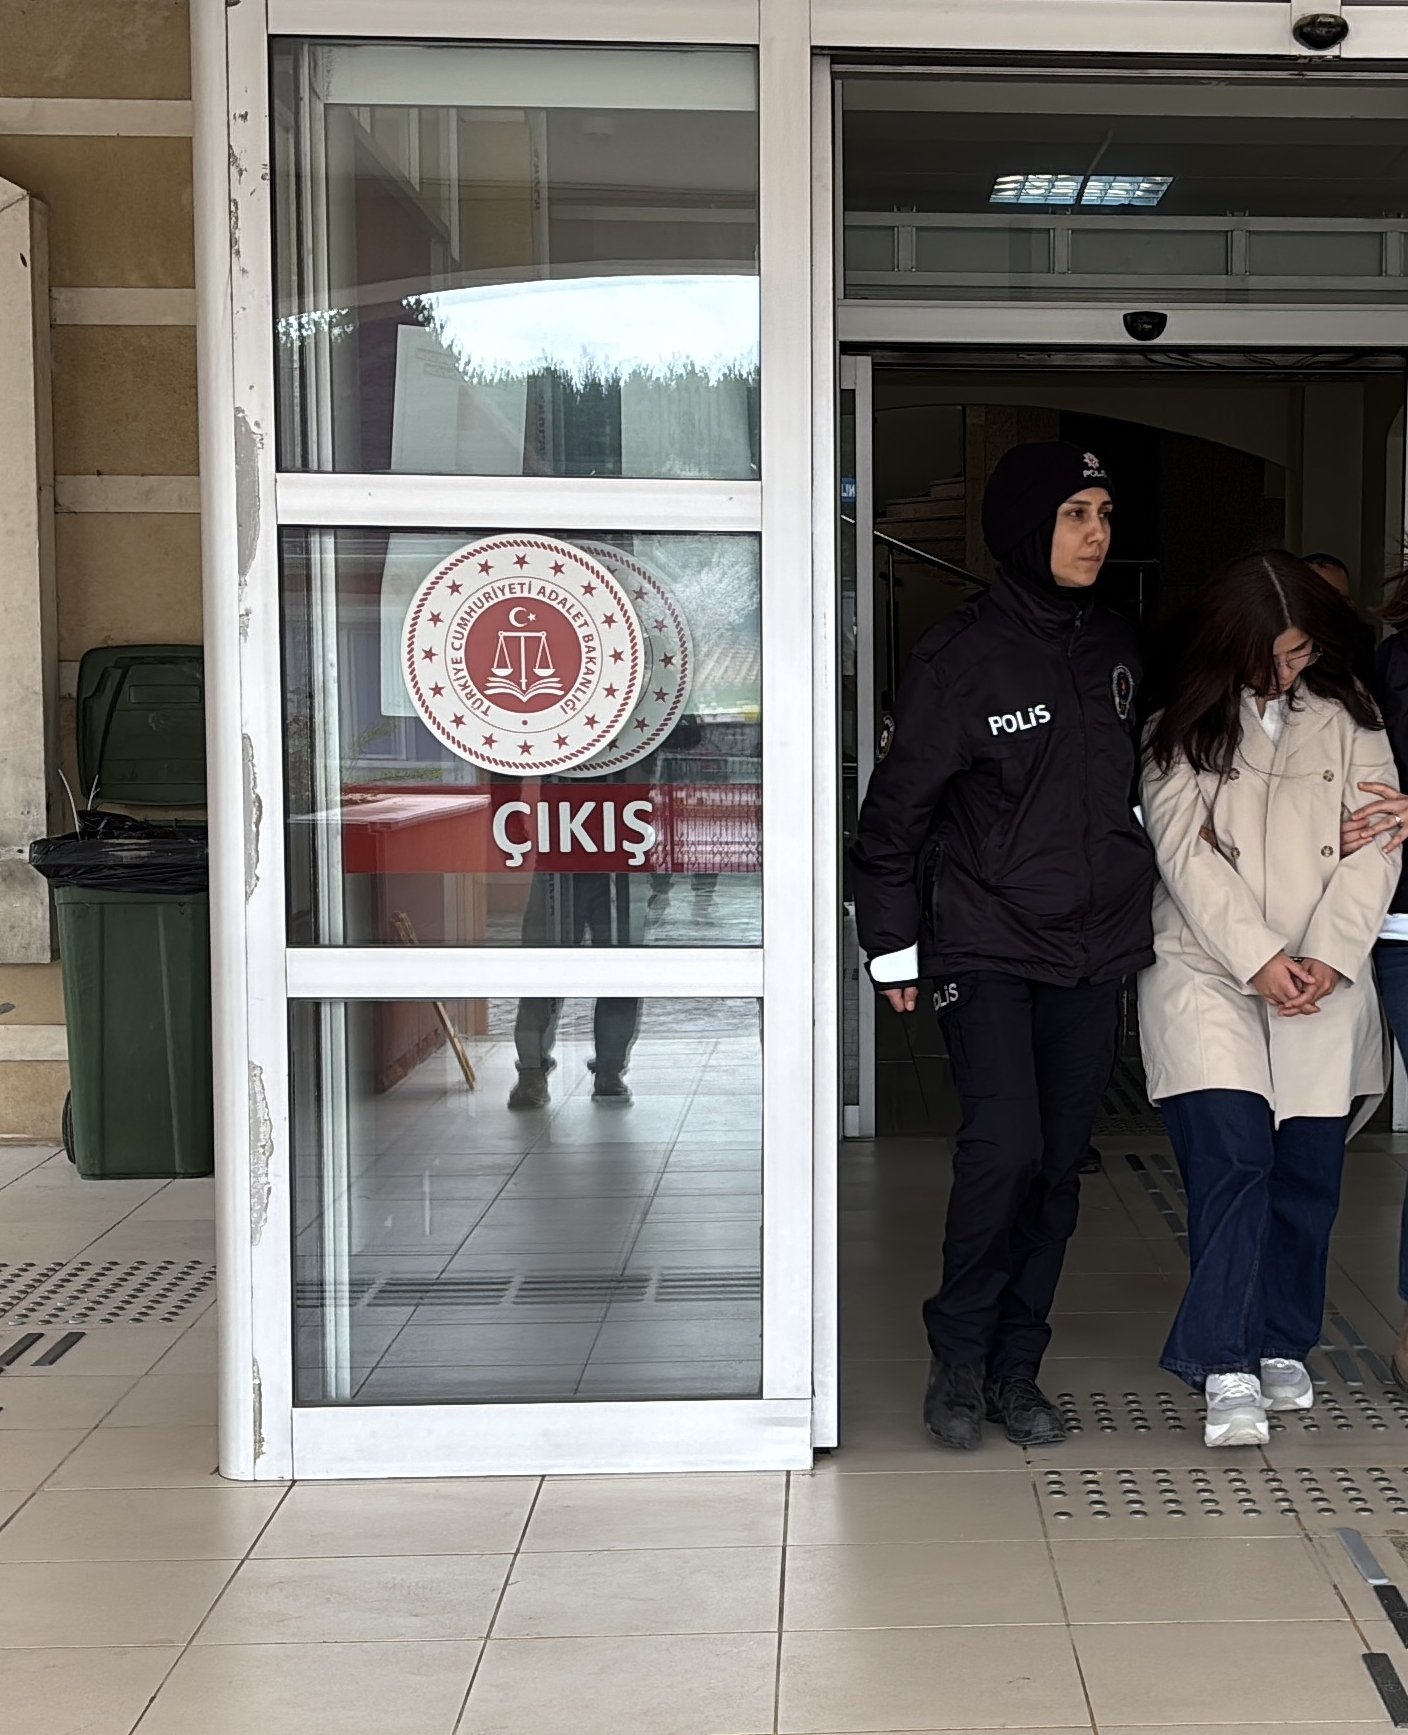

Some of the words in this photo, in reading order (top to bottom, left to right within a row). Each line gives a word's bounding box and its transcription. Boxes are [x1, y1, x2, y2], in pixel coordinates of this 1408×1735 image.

[451, 581, 533, 652] CUMHURİYETİ
[537, 585, 589, 630] ADALET
[452, 657, 492, 717] TÜRKİYE
[560, 634, 598, 716] BAKANLIĞI
[492, 800, 656, 868] ÇIKIŞ
